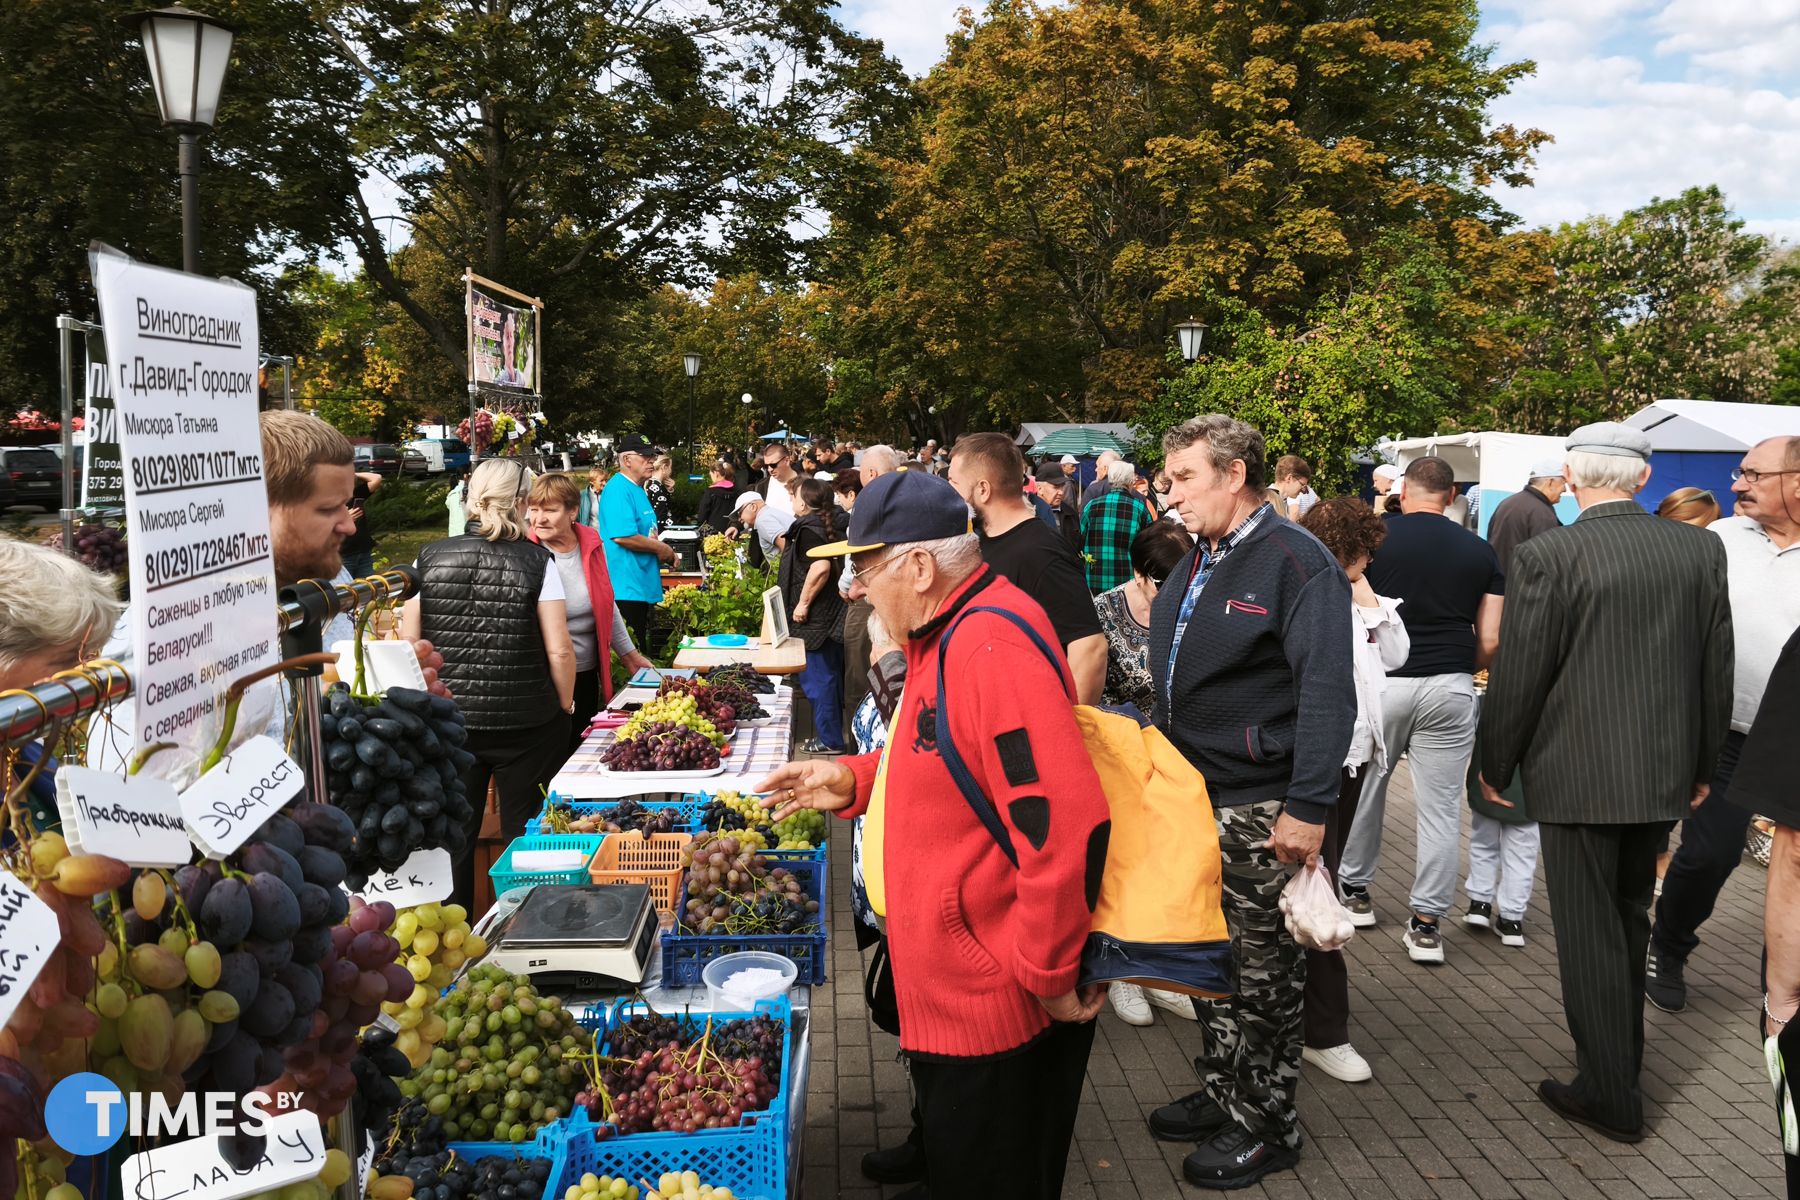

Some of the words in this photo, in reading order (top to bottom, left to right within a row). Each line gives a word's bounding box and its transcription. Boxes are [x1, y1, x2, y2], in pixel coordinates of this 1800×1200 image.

[137, 297, 242, 344] Виноградник
[89, 407, 120, 444] ВИ
[125, 413, 174, 440] Мисюра
[175, 413, 218, 433] Татьяна
[139, 508, 187, 533] Мисюра
[188, 499, 225, 526] Сергей
[148, 598, 201, 629] Саженцы
[204, 595, 210, 610] в
[212, 583, 244, 606] любую
[246, 576, 268, 595] точку
[147, 622, 213, 666] Беларуси!!!
[146, 672, 197, 706] Свежая,
[200, 653, 239, 684] вкусная
[241, 639, 269, 665] ягодка
[144, 725, 152, 742] с
[156, 696, 214, 736] середины
